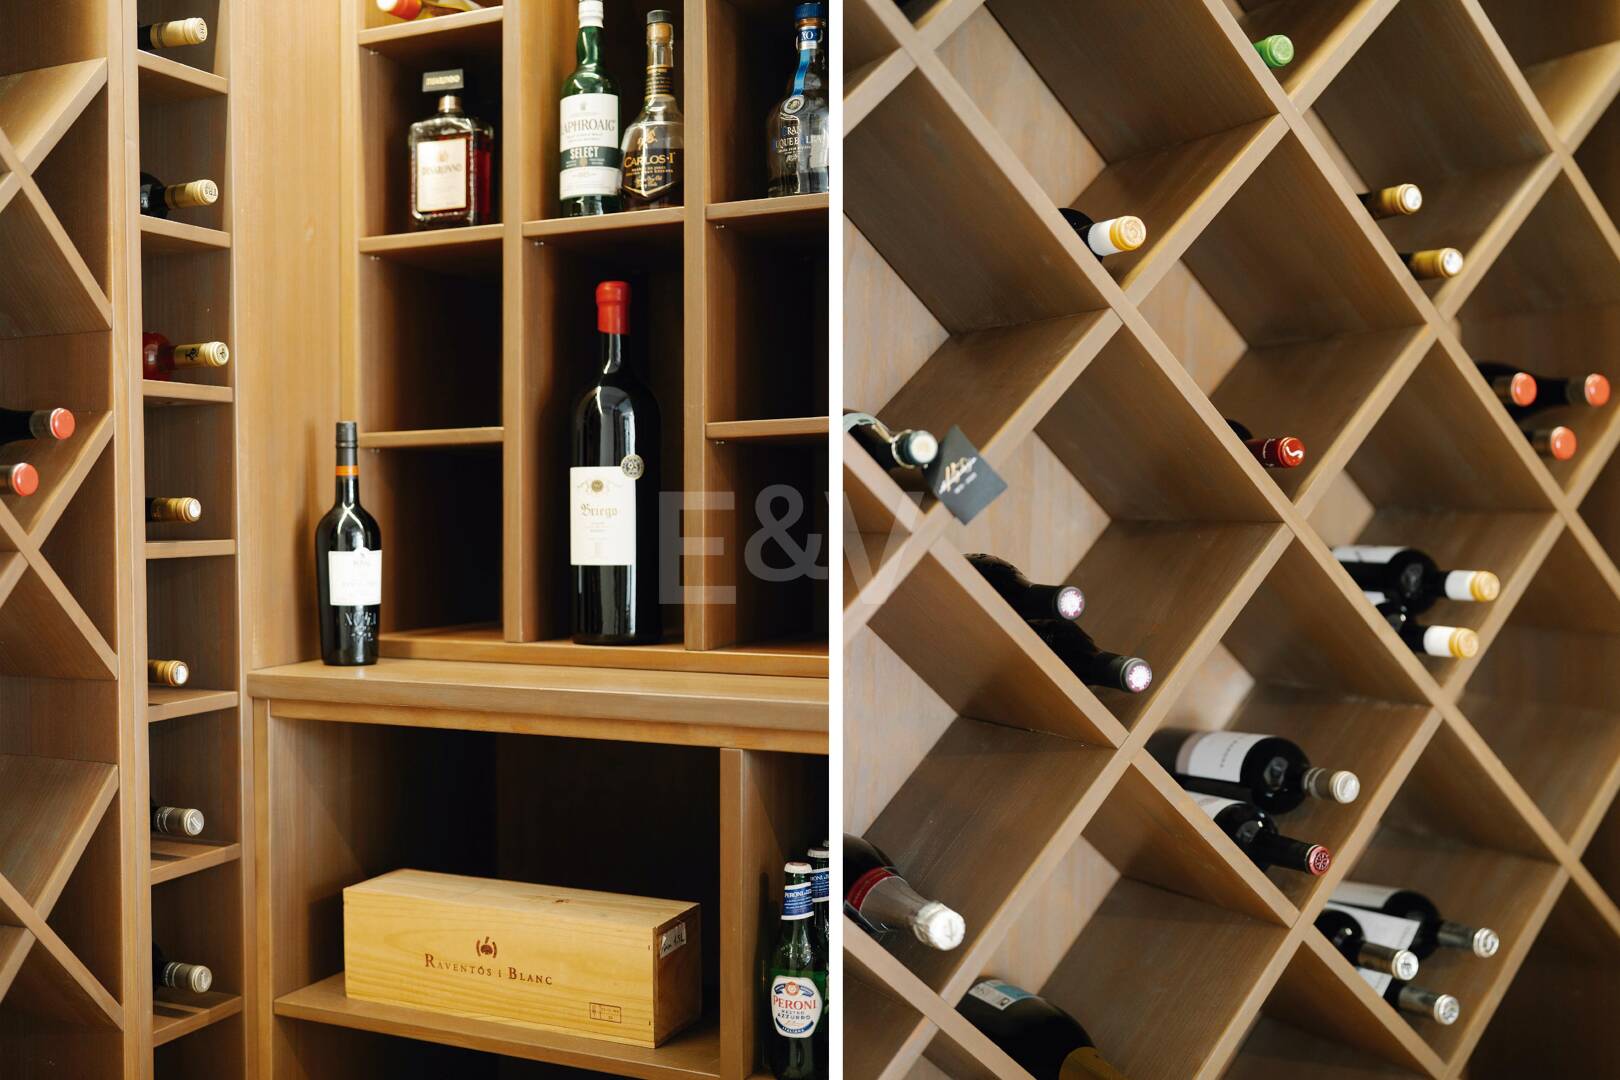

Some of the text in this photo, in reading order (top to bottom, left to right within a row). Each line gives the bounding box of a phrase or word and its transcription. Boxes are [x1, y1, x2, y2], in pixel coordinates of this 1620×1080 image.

[801, 30, 814, 41] XO
[569, 145, 600, 160] SELECT
[580, 503, 618, 518] Briego
[424, 953, 491, 977] RAVENTÓS
[508, 966, 553, 985] BLANC
[773, 994, 817, 1011] PERONI
